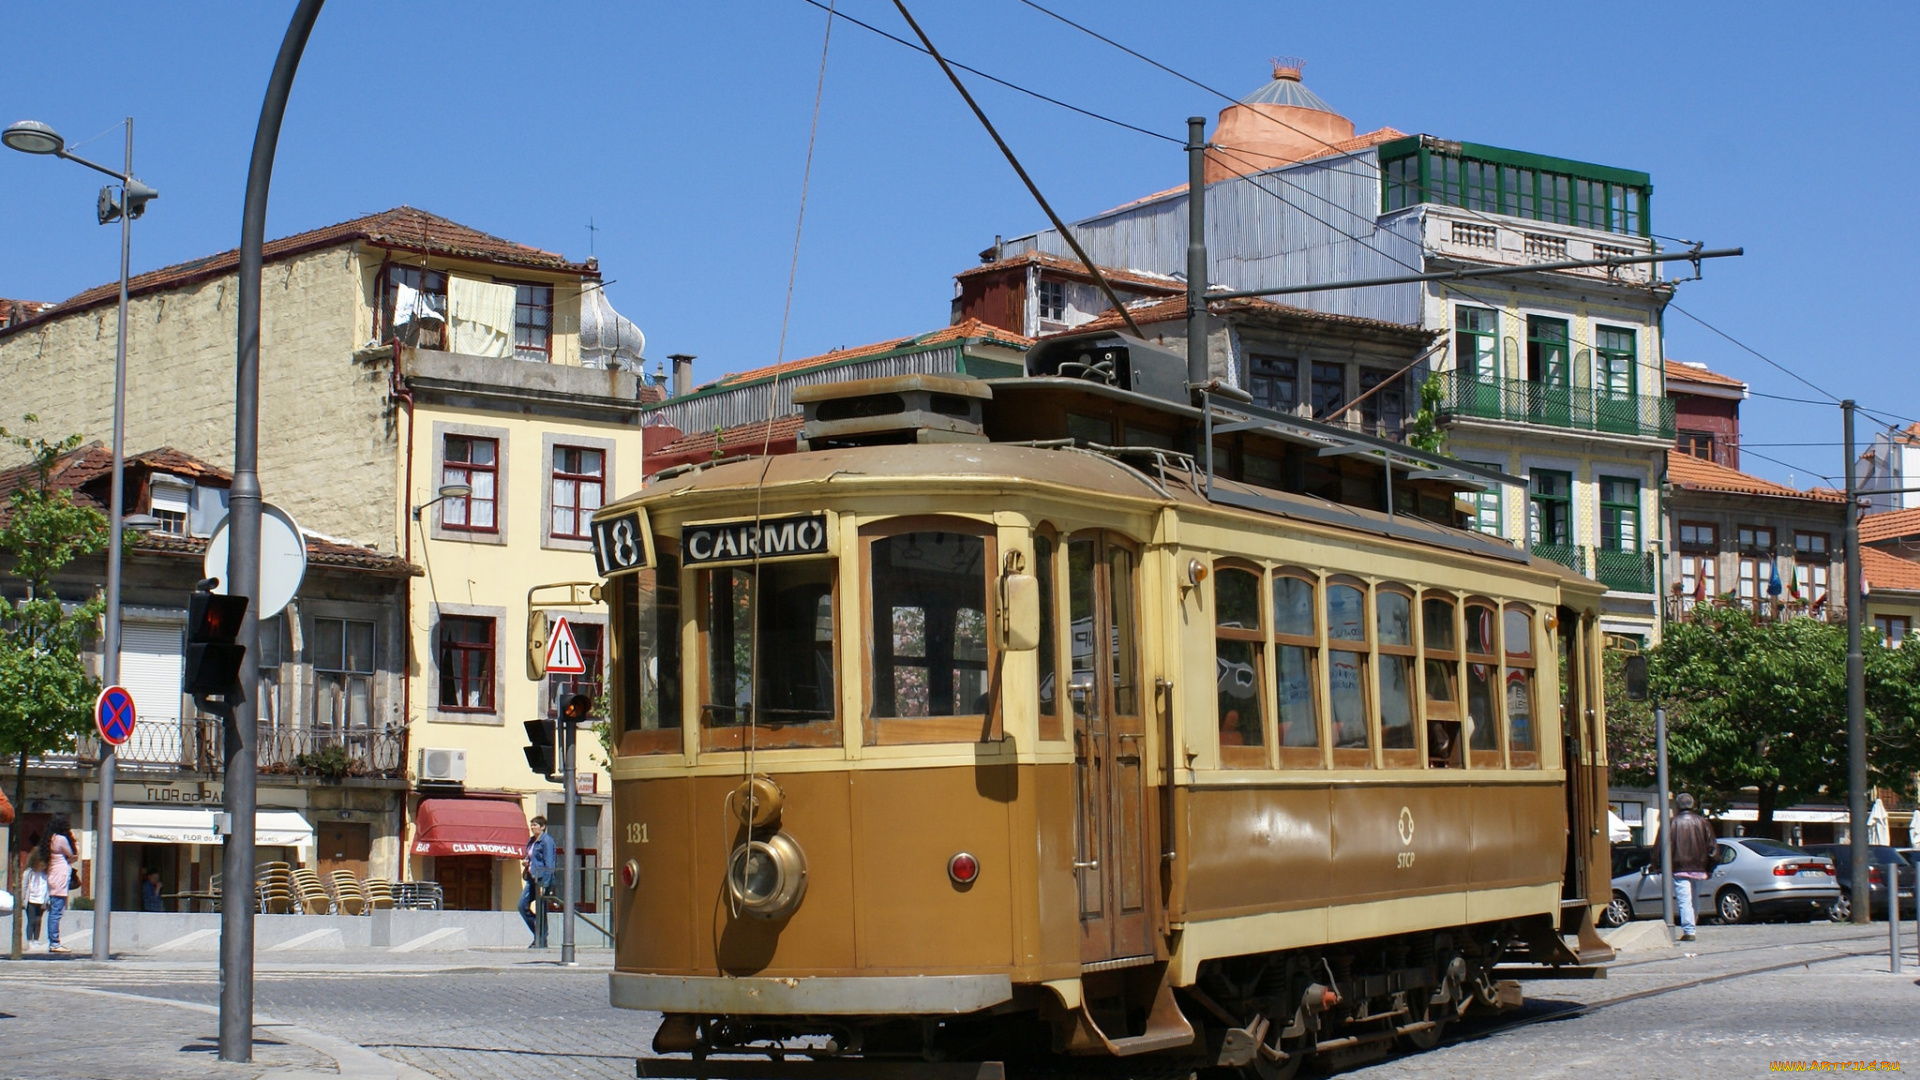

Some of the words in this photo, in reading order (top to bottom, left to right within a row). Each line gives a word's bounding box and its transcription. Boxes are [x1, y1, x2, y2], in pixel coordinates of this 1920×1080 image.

[597, 519, 638, 572] 18
[689, 520, 822, 560] CARMO
[148, 788, 180, 801] FLOR
[626, 822, 649, 844] 131
[415, 843, 430, 853] BAR
[452, 843, 477, 853] CLUB
[476, 844, 518, 855] TROPICAL
[1397, 851, 1416, 869] STCP
